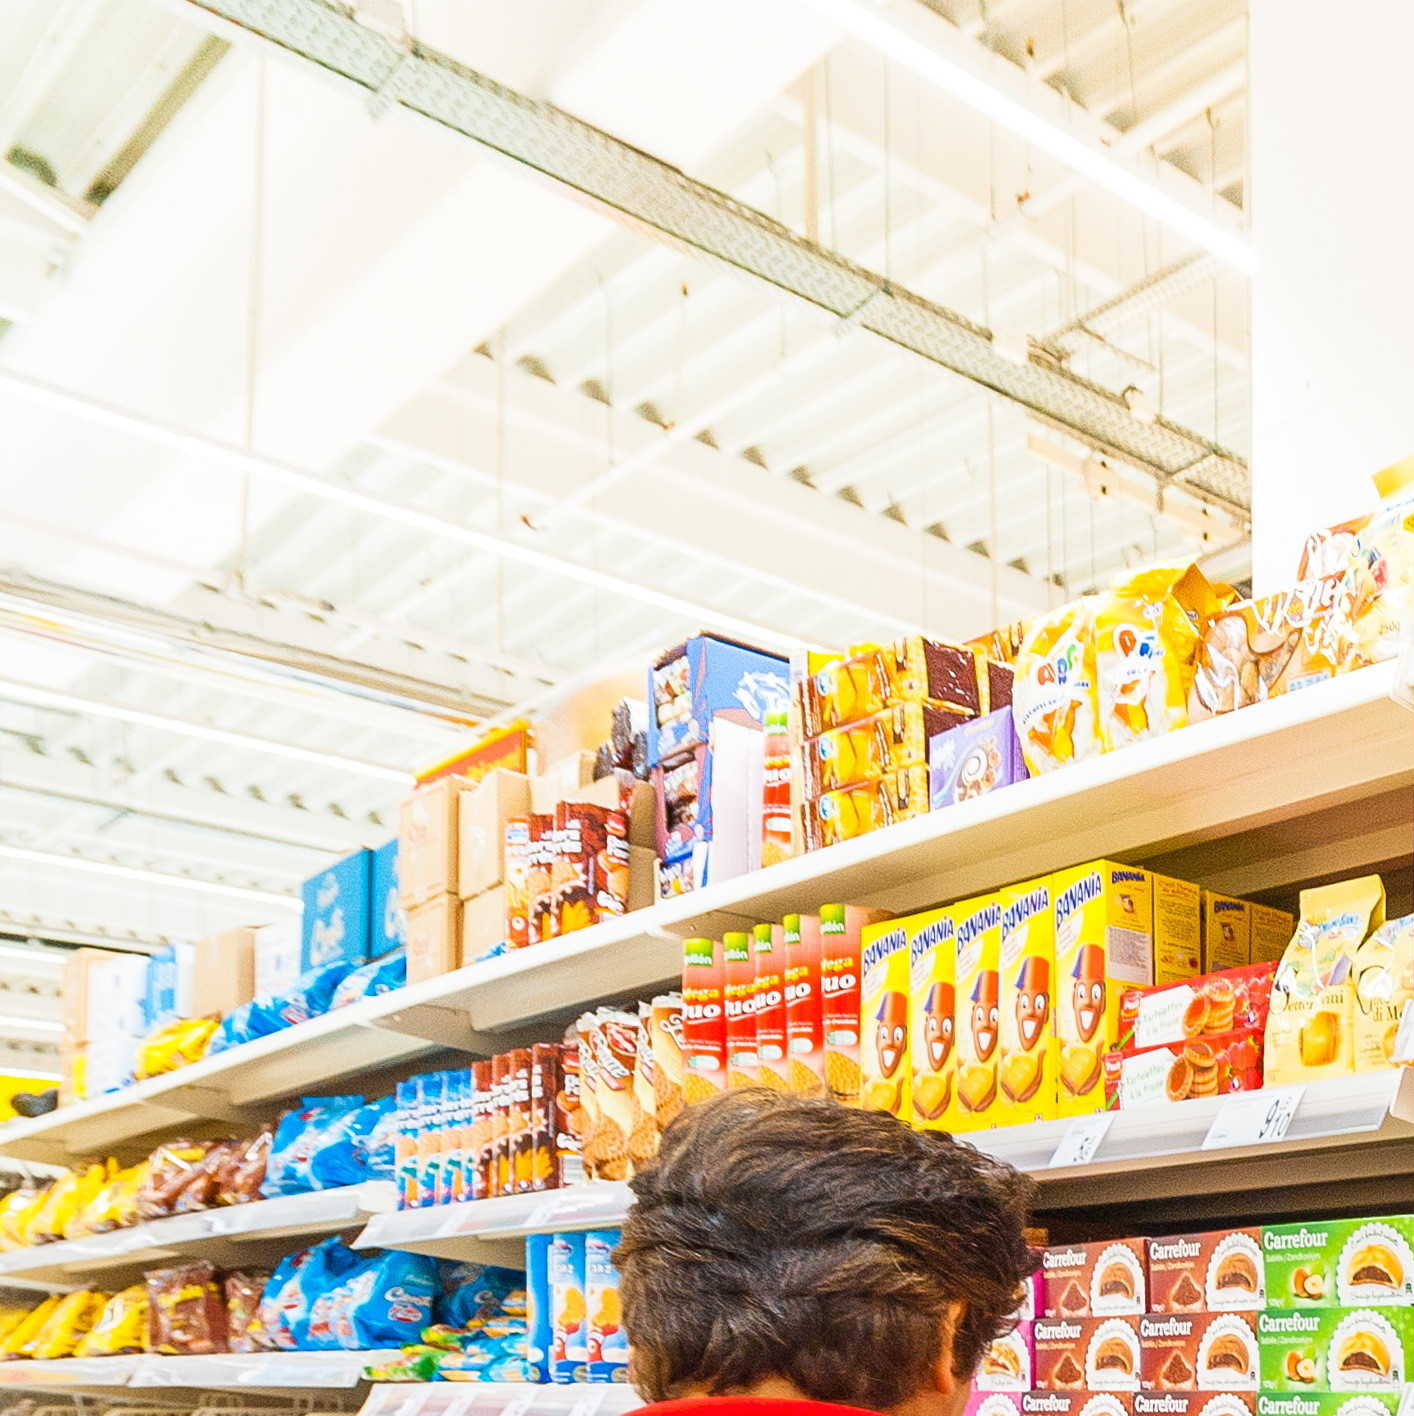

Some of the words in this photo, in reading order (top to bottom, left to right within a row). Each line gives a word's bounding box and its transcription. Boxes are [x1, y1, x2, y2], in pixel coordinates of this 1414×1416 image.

[1055, 871, 1103, 928] BANANIA
[863, 927, 907, 977] BANANIA
[1264, 1229, 1328, 1251] Carrefour
